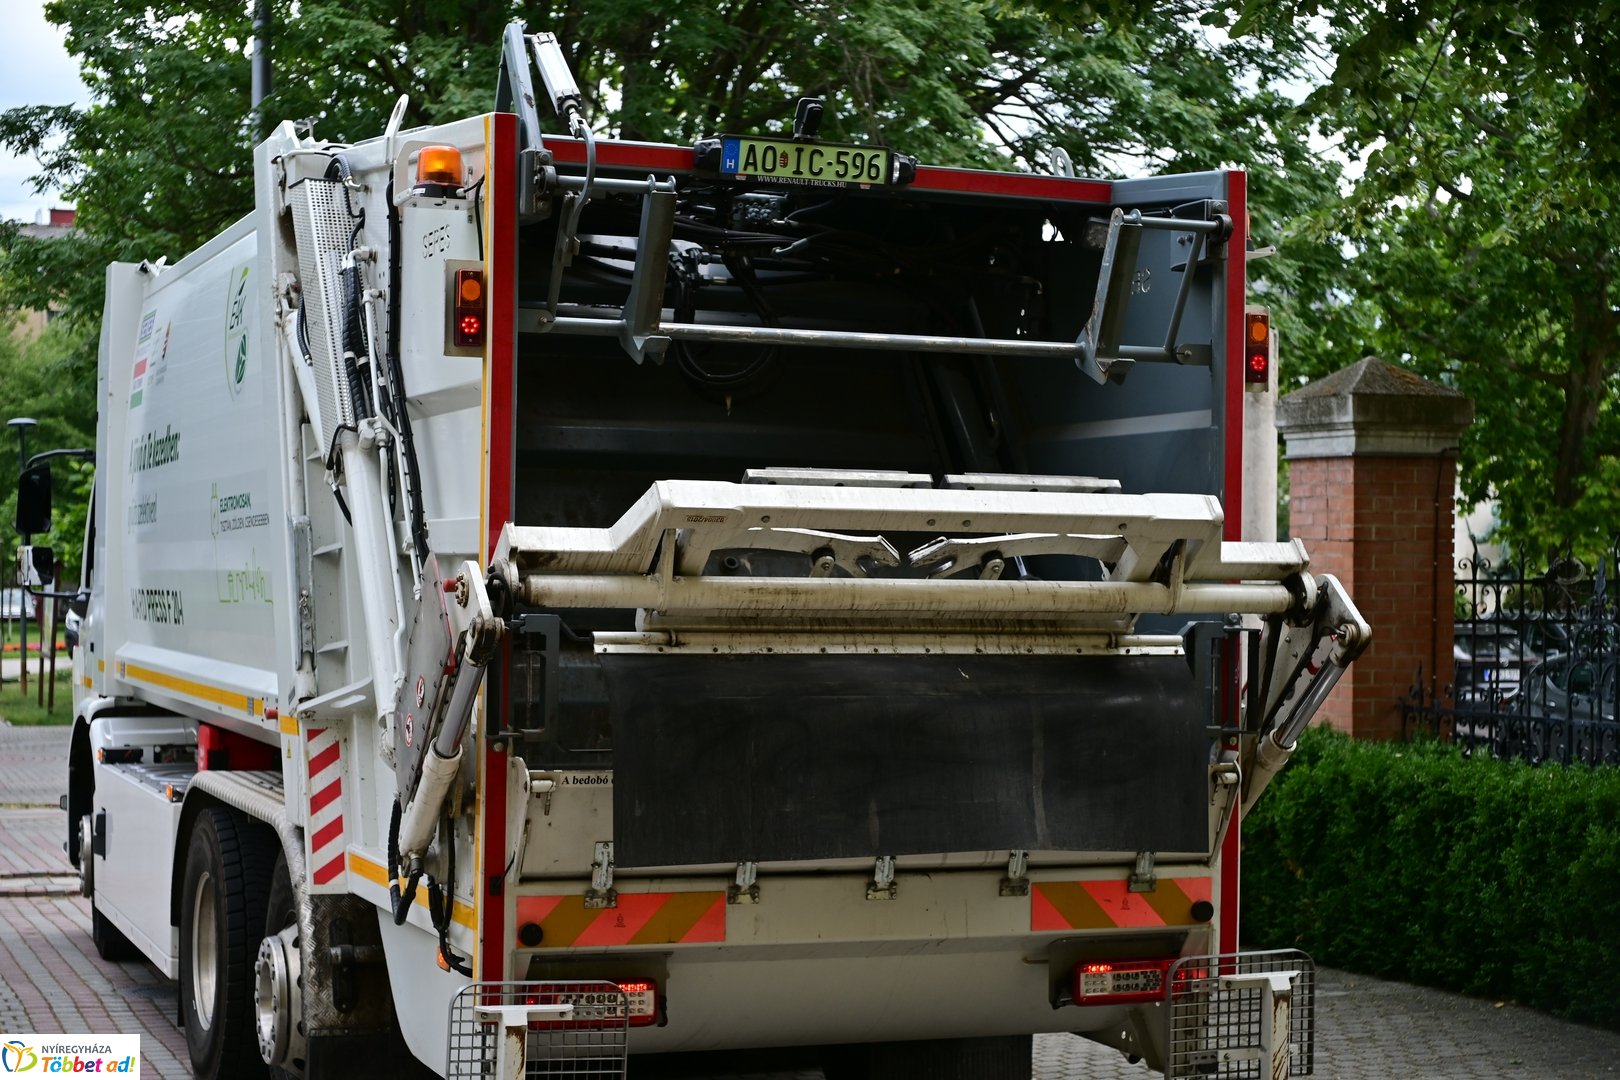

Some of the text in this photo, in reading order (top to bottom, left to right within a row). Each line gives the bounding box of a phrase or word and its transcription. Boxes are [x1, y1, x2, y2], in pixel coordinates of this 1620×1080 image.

[726, 159, 735, 169] H
[743, 143, 881, 181] AO IC-596
[757, 175, 848, 189] WWW.RENAULT-TRUCKS.HU
[146, 589, 167, 623] PRESS
[561, 776, 570, 785] A
[572, 775, 609, 785] bedobó
